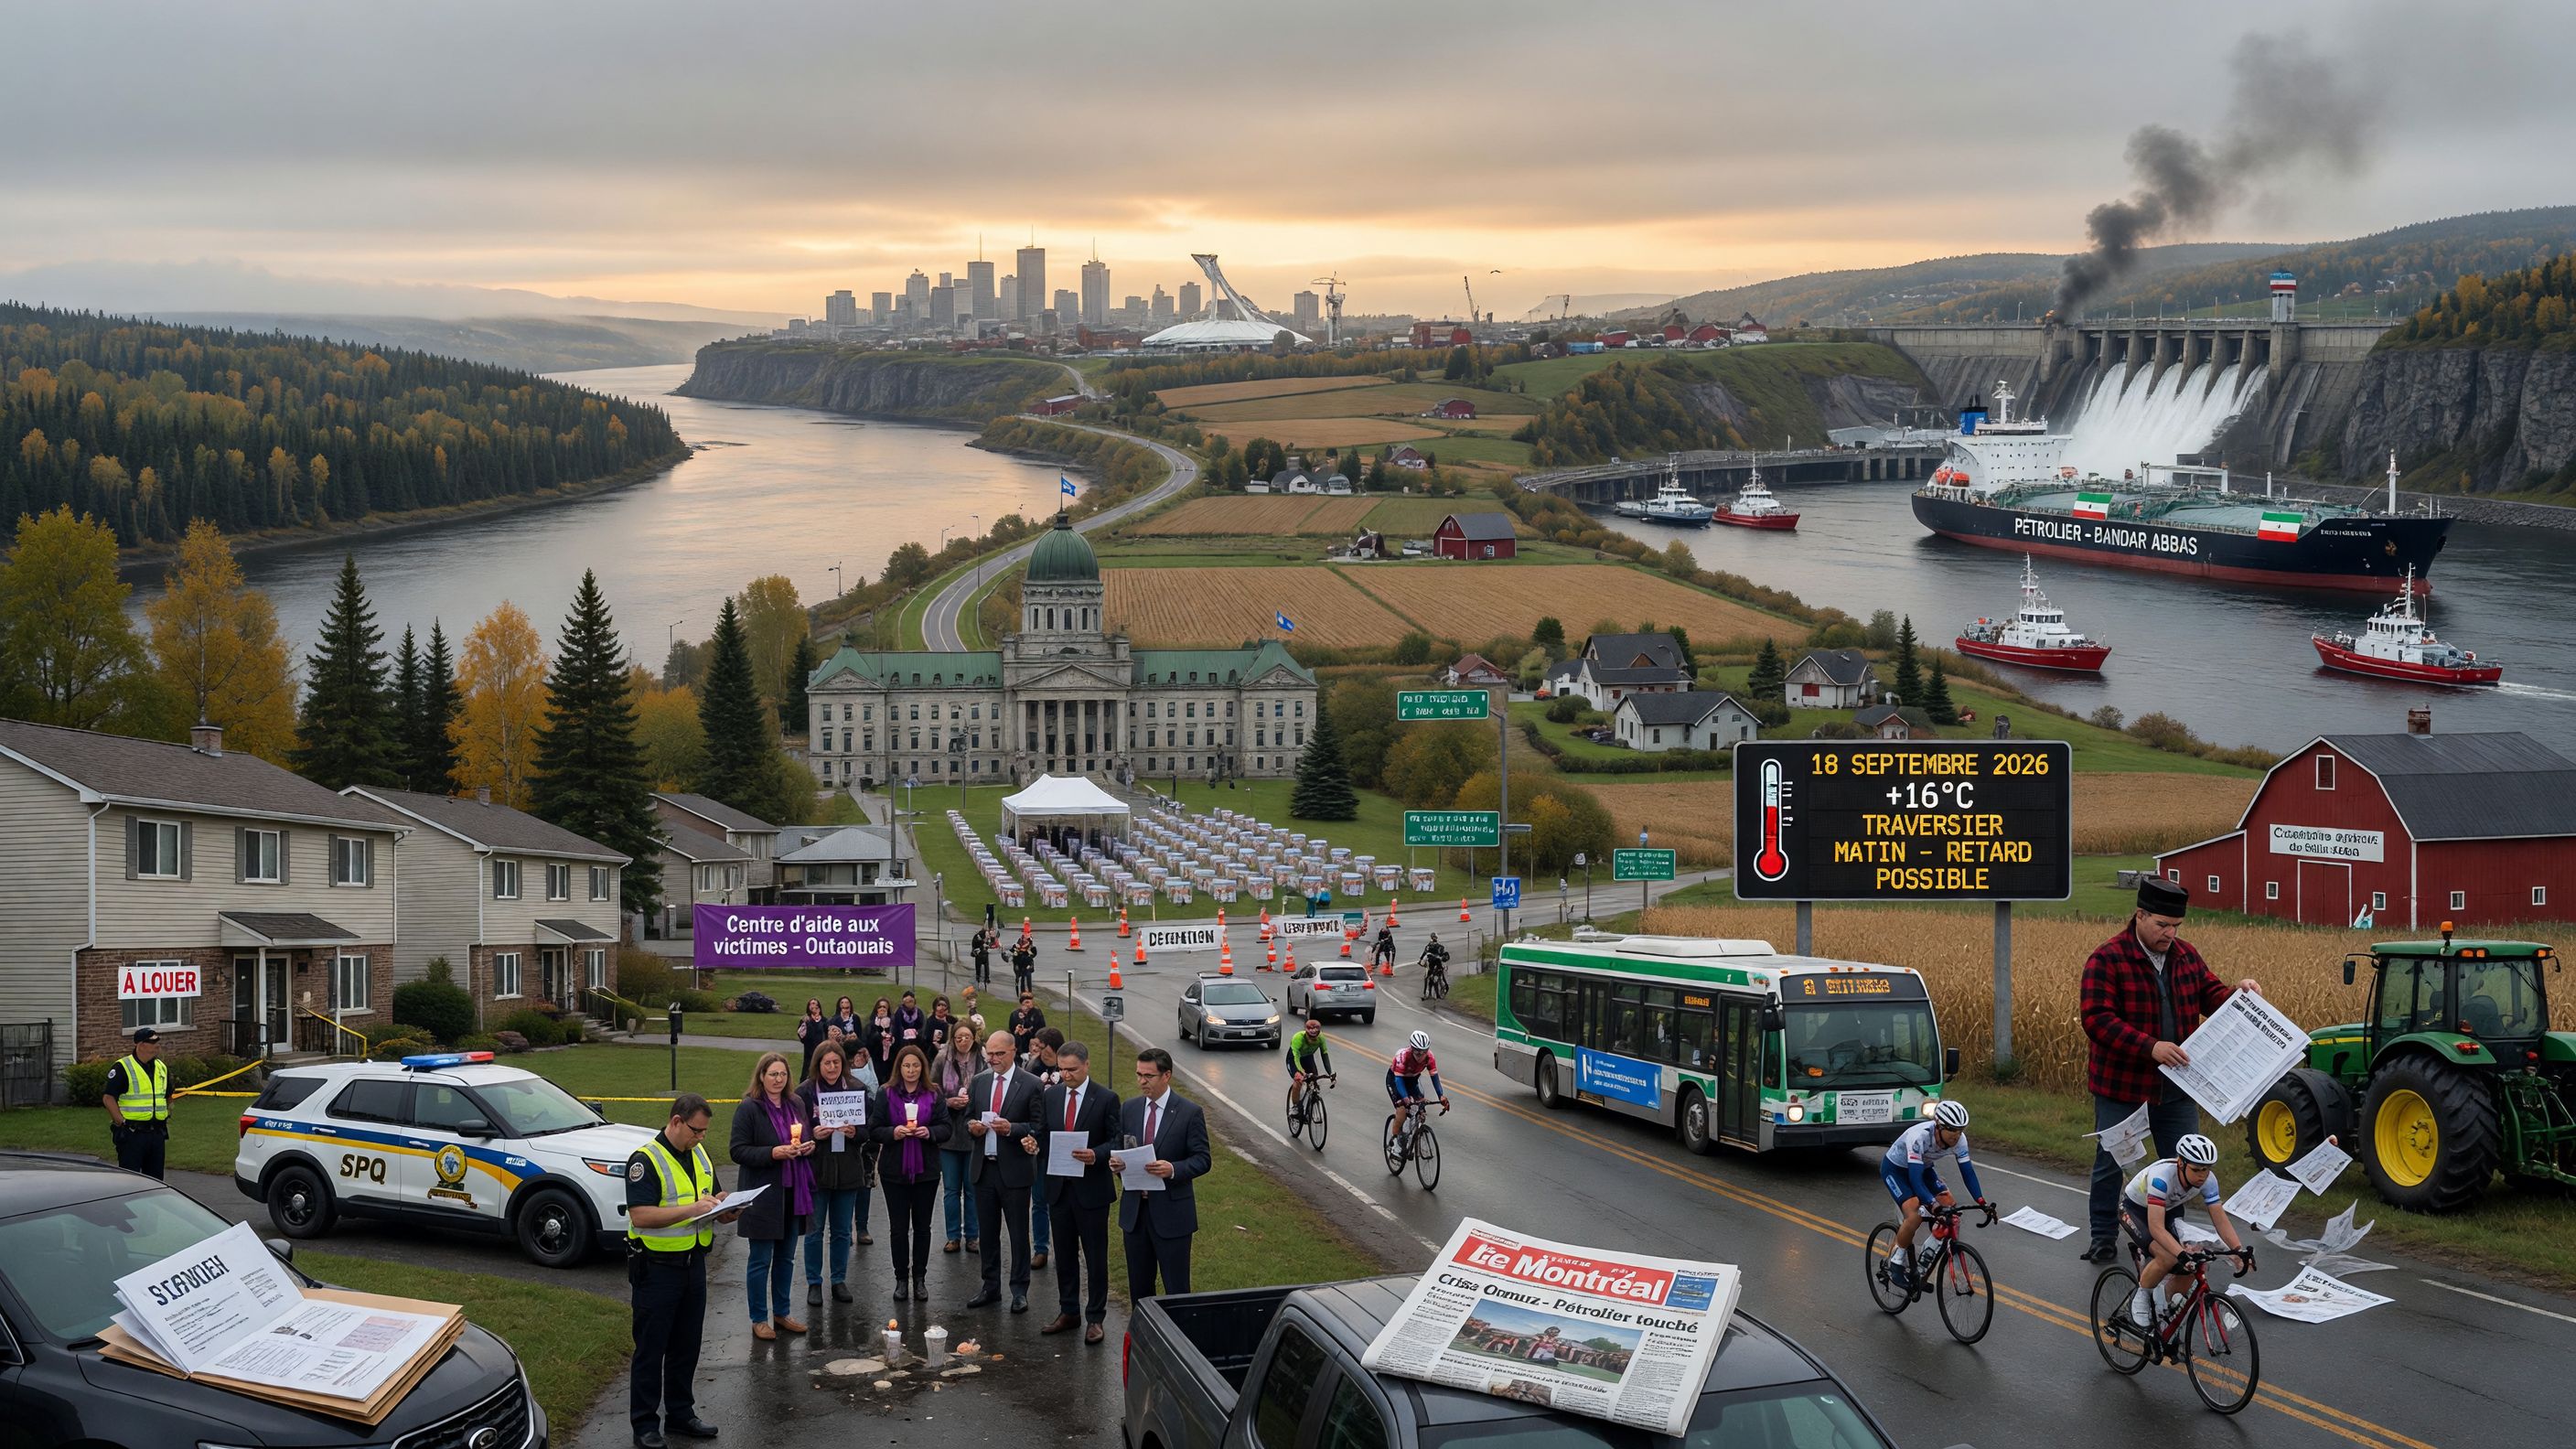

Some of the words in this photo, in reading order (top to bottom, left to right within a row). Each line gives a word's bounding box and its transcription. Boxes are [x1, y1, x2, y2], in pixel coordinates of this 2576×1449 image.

[2094, 526, 2147, 550] BANDAR
[2151, 532, 2198, 555] ABBAS
[1811, 753, 1839, 776] 18
[1851, 753, 1979, 776] SEPTEMBRE
[1992, 753, 2049, 776] 2026
[1885, 781, 1974, 809] +16°C
[1862, 813, 2003, 836] TRAVERSIER
[1834, 841, 1905, 863] MATIN
[1947, 841, 2032, 863] RETARD
[1876, 867, 1990, 890] POSSIBLE
[726, 915, 785, 933] Centre
[789, 915, 843, 933] d'aide
[847, 918, 880, 933] aux
[713, 938, 788, 955] victimes
[805, 937, 894, 955] Outaouais
[142, 971, 197, 993] LOUER
[339, 1153, 387, 1186] SPQ
[1512, 1254, 1667, 1302] Montréal
[1636, 1315, 1699, 1334] touché
